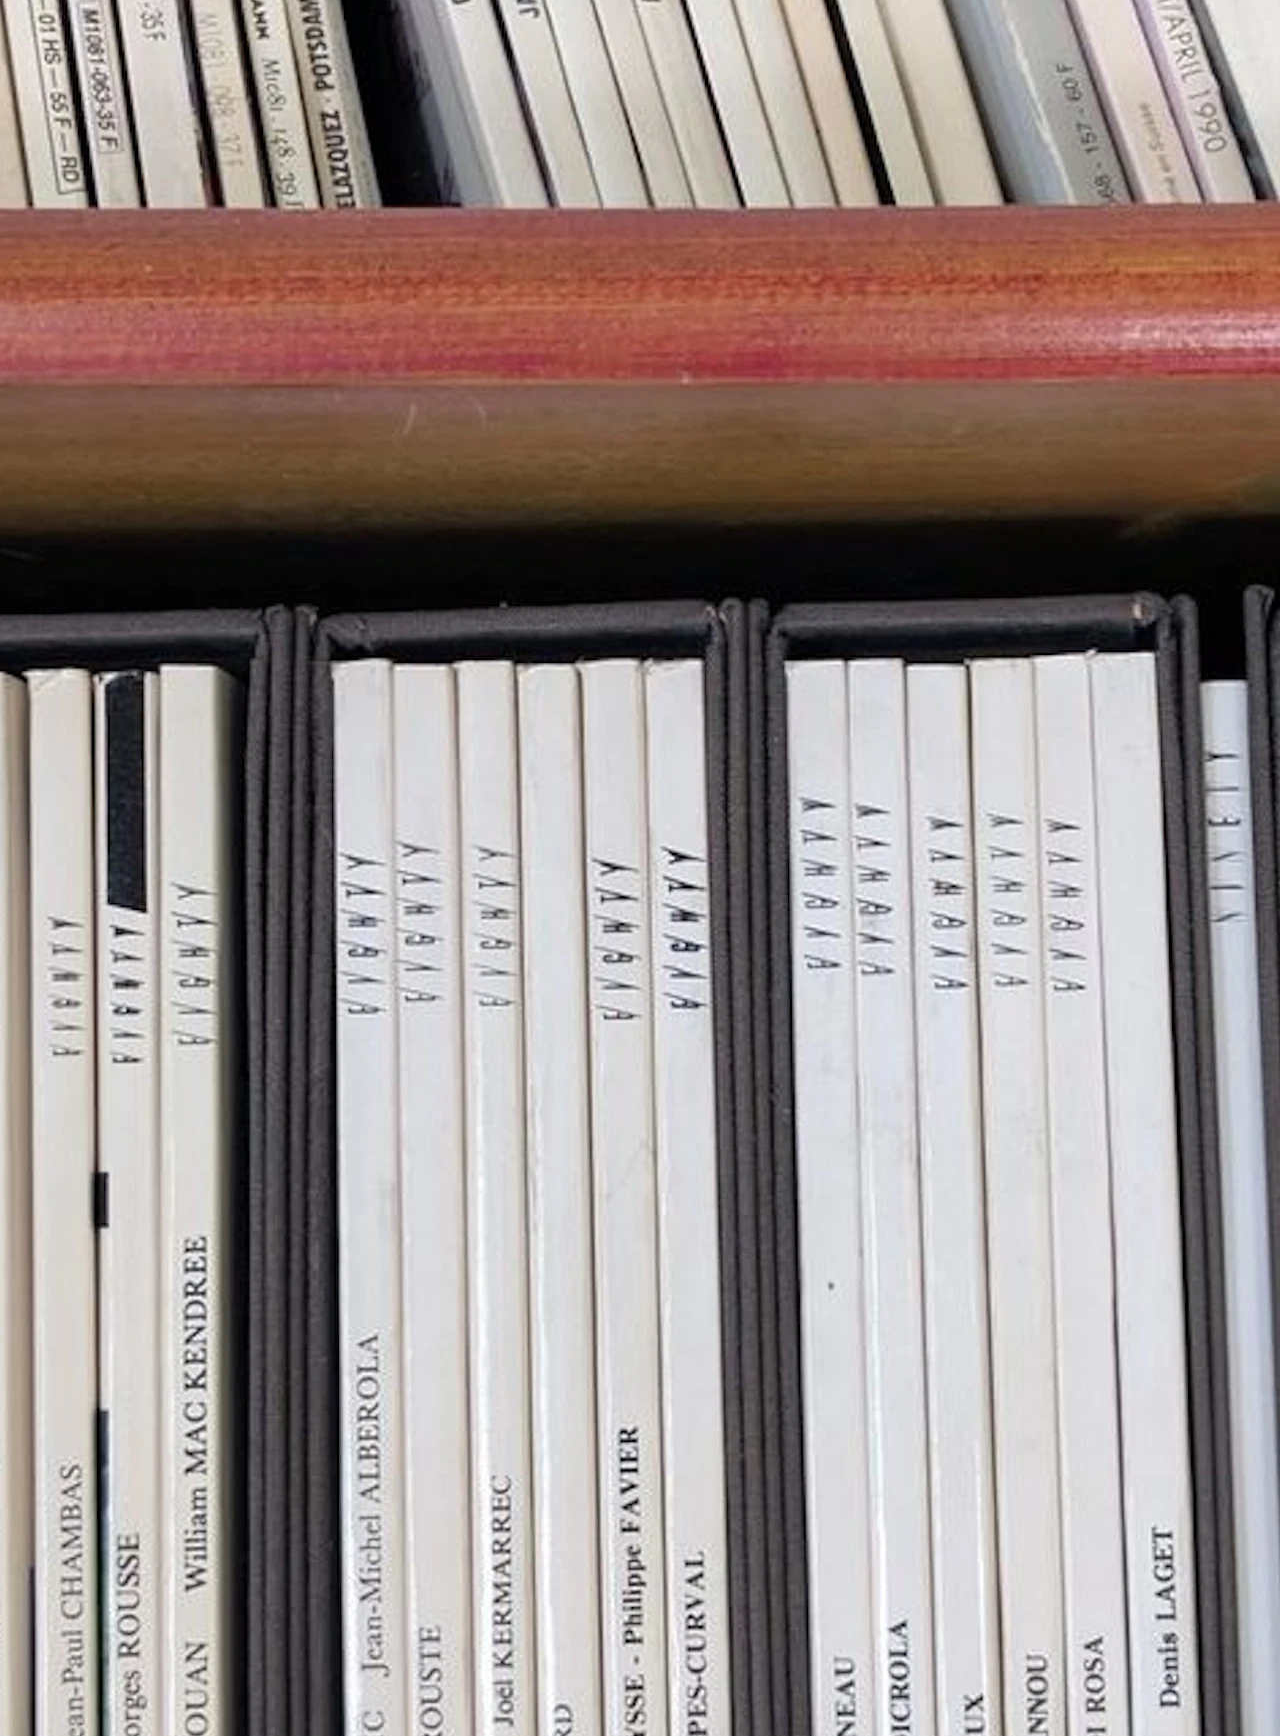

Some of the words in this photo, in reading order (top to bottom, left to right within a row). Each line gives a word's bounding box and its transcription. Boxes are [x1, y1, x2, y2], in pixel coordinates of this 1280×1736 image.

[182, 1235, 207, 1391] KENDREE
[182, 1401, 207, 1475] MAC
[59, 1463, 83, 1620] CHAMBAS
[183, 1486, 208, 1592] William
[1082, 1635, 1106, 1713] ROSA
